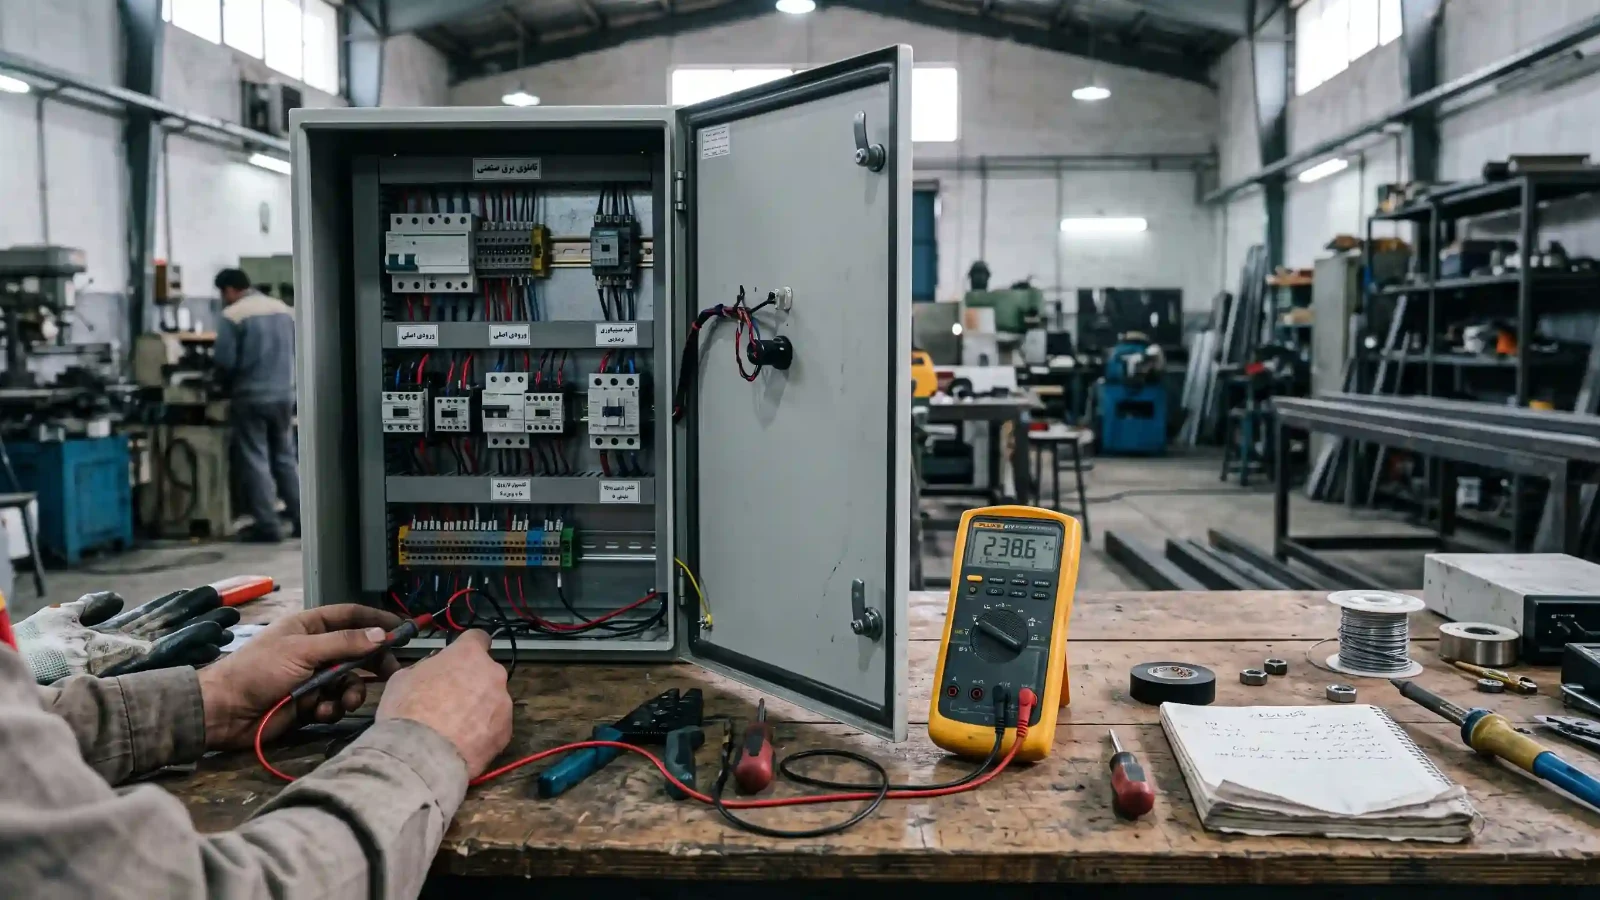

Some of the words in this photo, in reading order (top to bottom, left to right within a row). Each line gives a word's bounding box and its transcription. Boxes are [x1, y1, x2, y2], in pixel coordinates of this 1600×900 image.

[501, 164, 515, 174] برق
[416, 332, 435, 340] ورودی
[508, 332, 527, 340] ورودی
[983, 536, 1037, 559] 238.6
